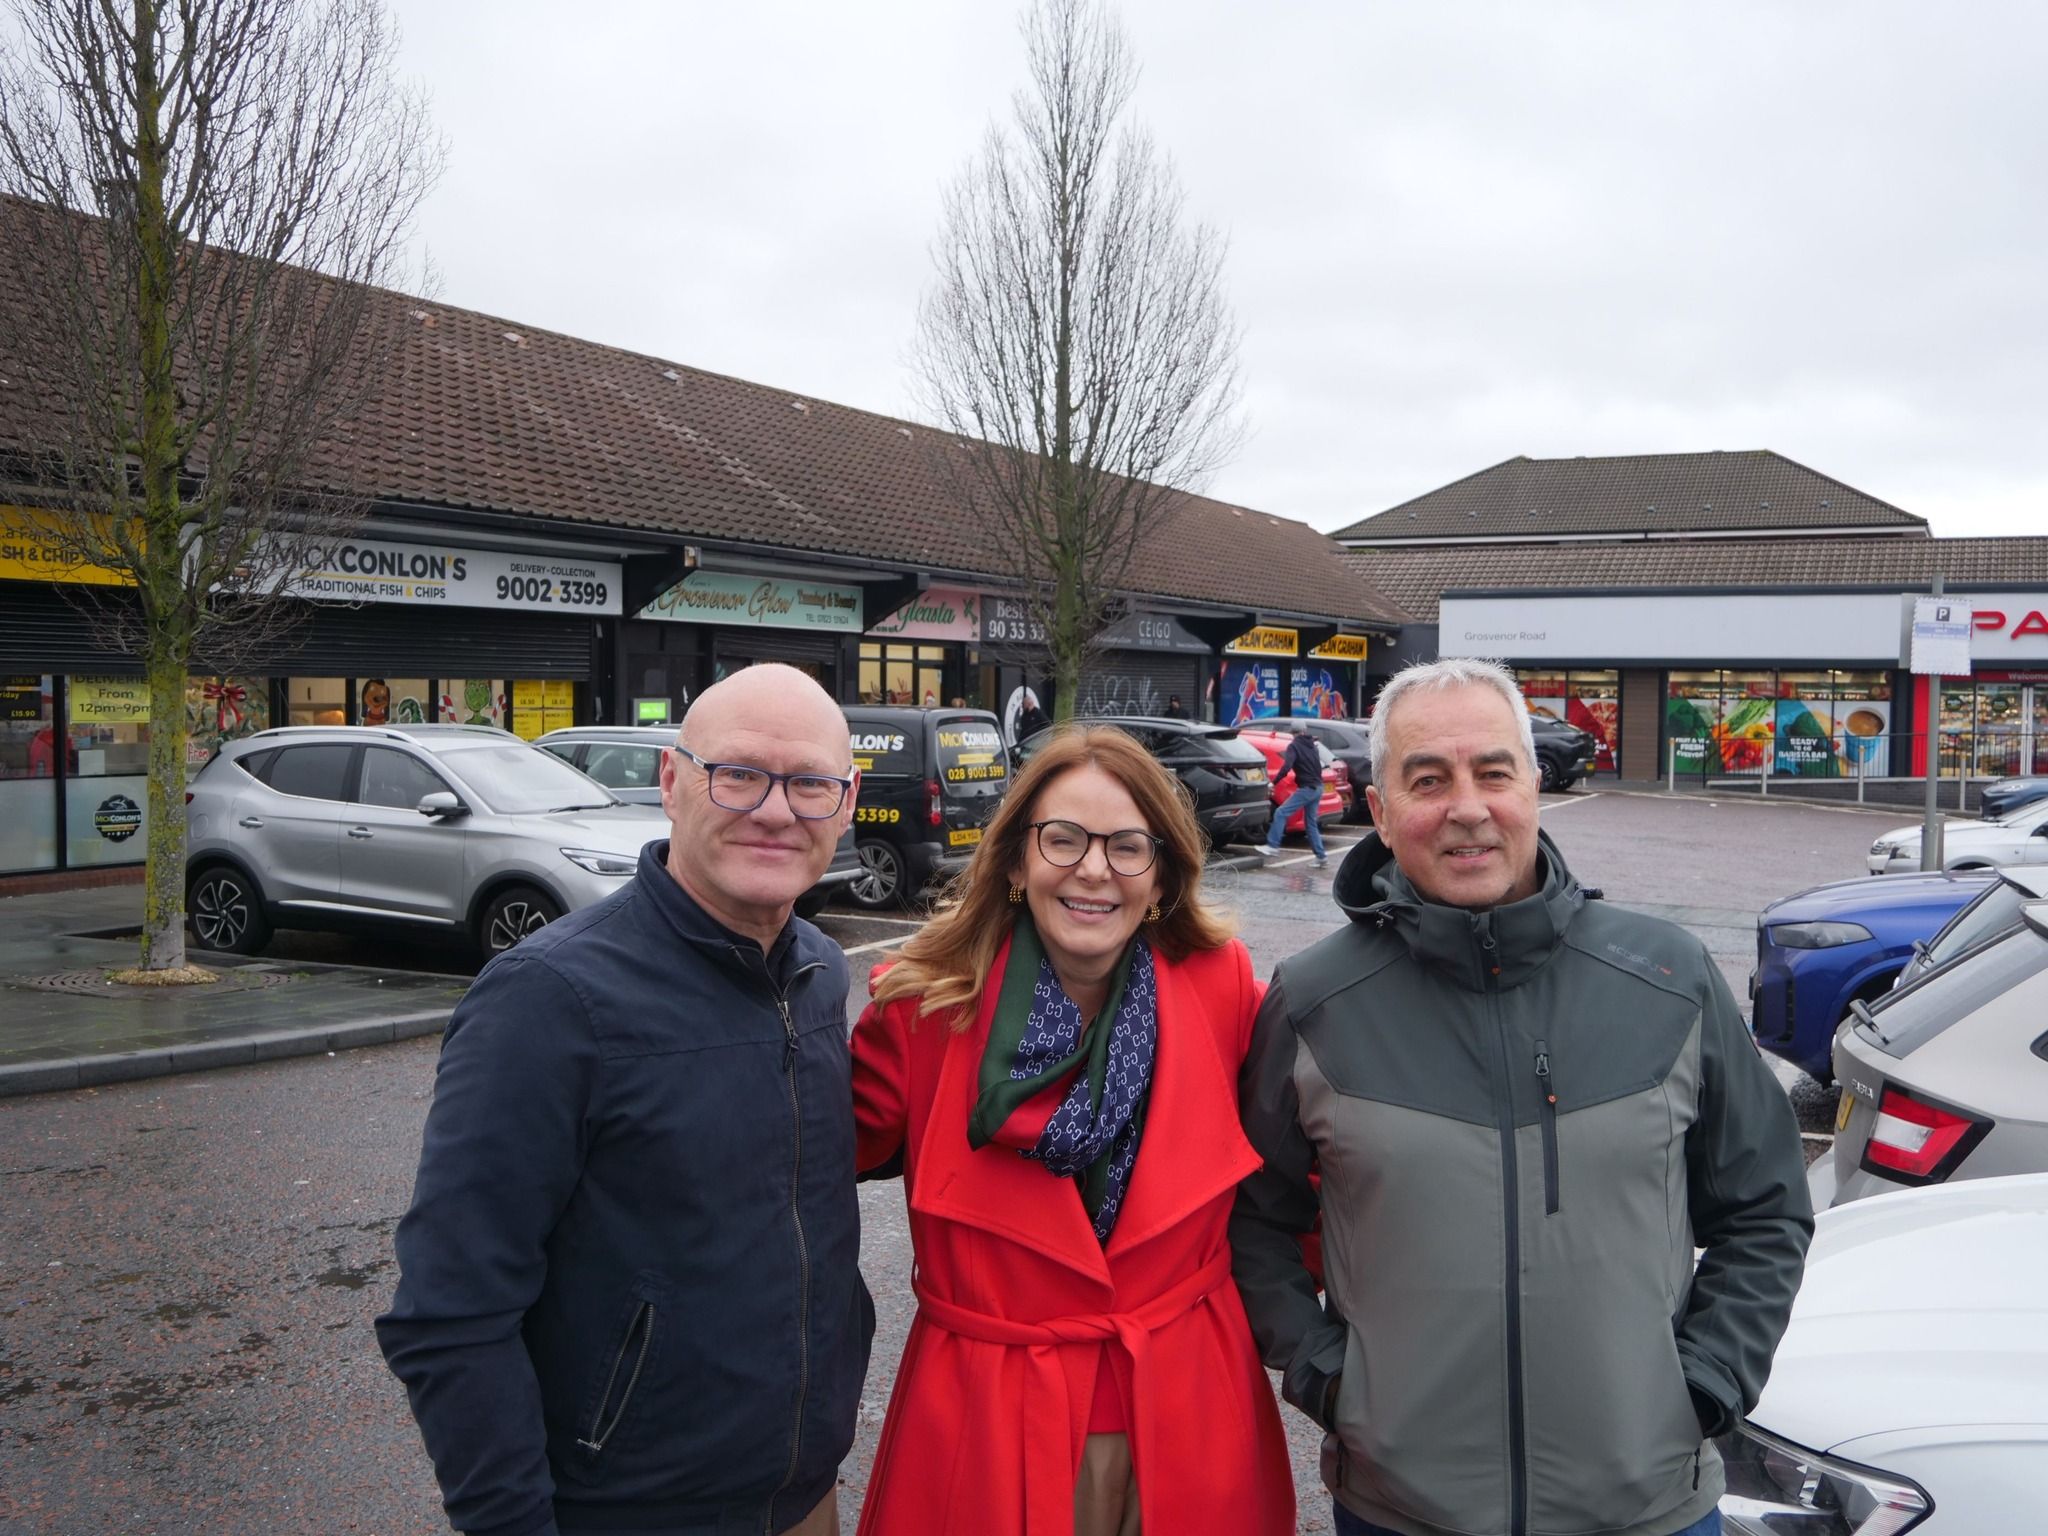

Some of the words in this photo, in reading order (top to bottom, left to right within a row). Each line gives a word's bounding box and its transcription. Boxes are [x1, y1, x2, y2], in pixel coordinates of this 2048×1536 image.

[29, 547, 38, 561] &
[510, 563, 546, 574] DELIVERY
[551, 566, 595, 578] COLLECTION
[300, 578, 377, 595] TRADITIONAL
[379, 584, 403, 597] FISH
[415, 587, 446, 599] CHIPS
[748, 582, 794, 623] Glow
[996, 600, 1025, 619] Best
[988, 620, 1006, 638] 90
[1464, 631, 1518, 642] Grosvenor
[1519, 631, 1546, 641] Road
[1239, 631, 1261, 648] SEAN
[1262, 633, 1296, 650] GRAHAM
[1337, 640, 1364, 656] GRAHAM
[98, 688, 135, 699] From
[1680, 743, 1705, 751] FRESH
[947, 768, 966, 780] 028
[967, 767, 987, 779] 9002
[856, 807, 900, 823] 3399
